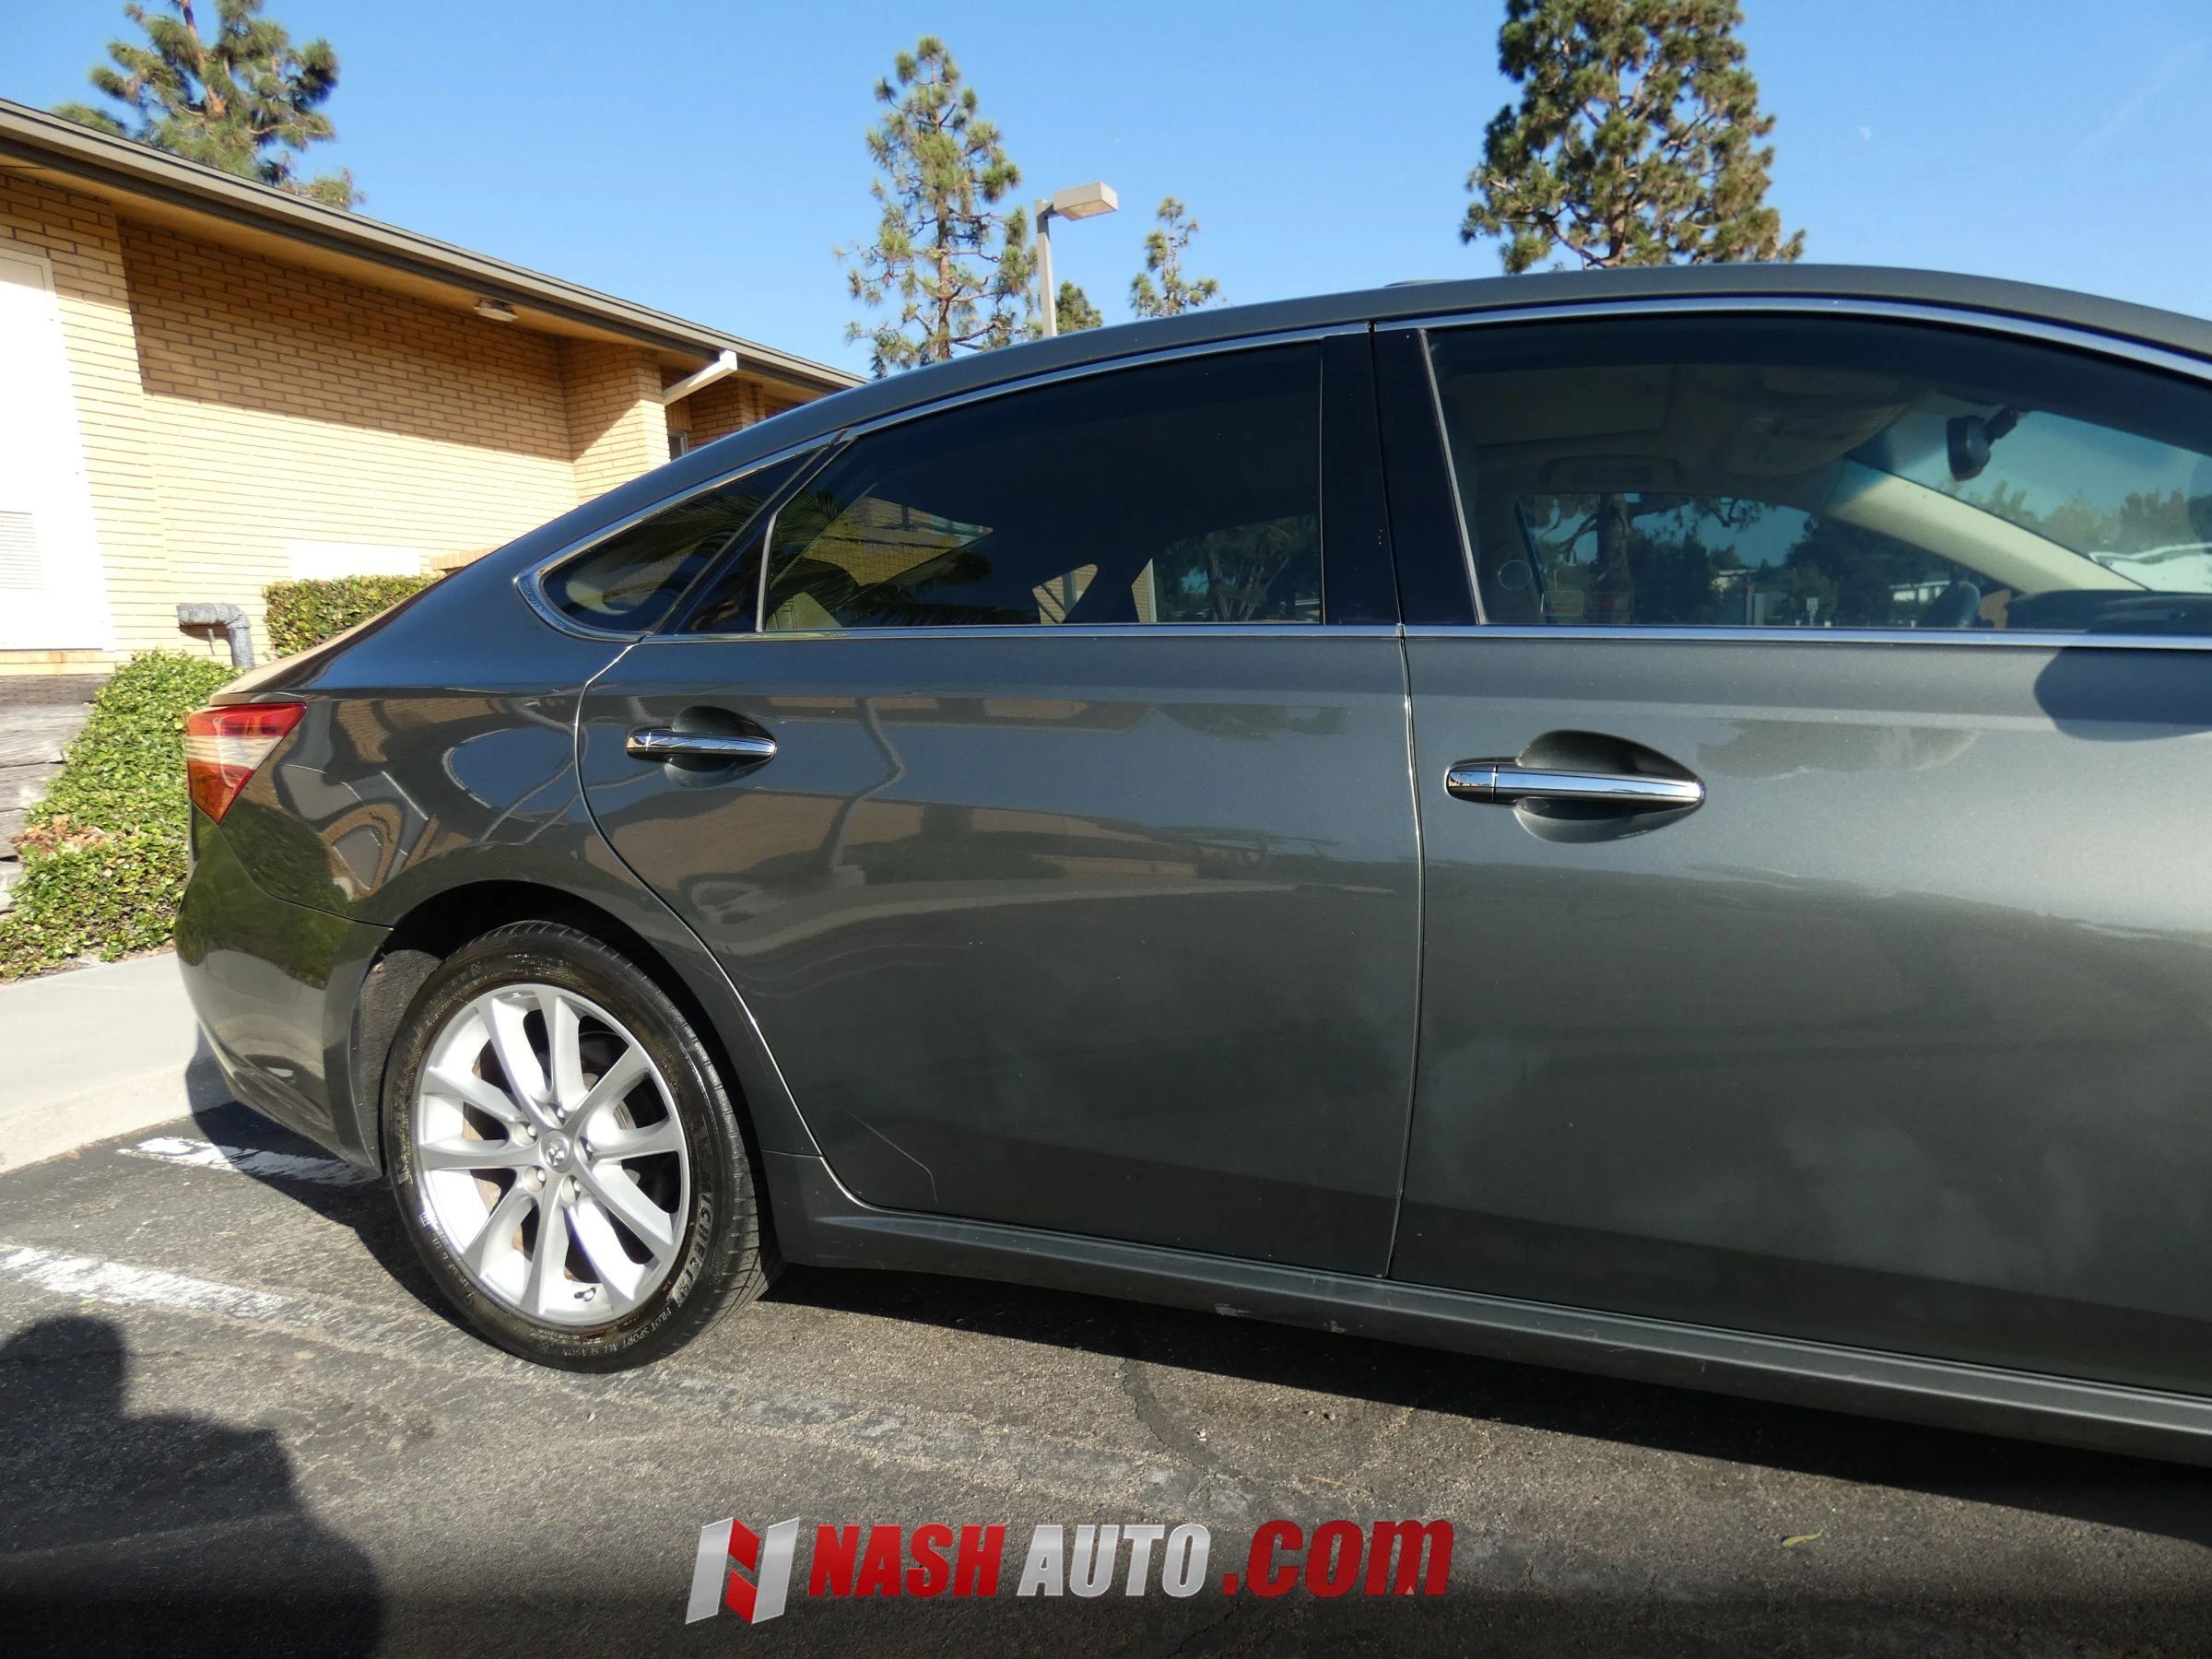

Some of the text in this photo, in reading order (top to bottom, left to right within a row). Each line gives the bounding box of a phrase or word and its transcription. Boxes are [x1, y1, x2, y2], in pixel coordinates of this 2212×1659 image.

[678, 1171, 712, 1301] MICHELIN
[650, 1305, 673, 1333] PILOT
[623, 1327, 651, 1348] SPORT
